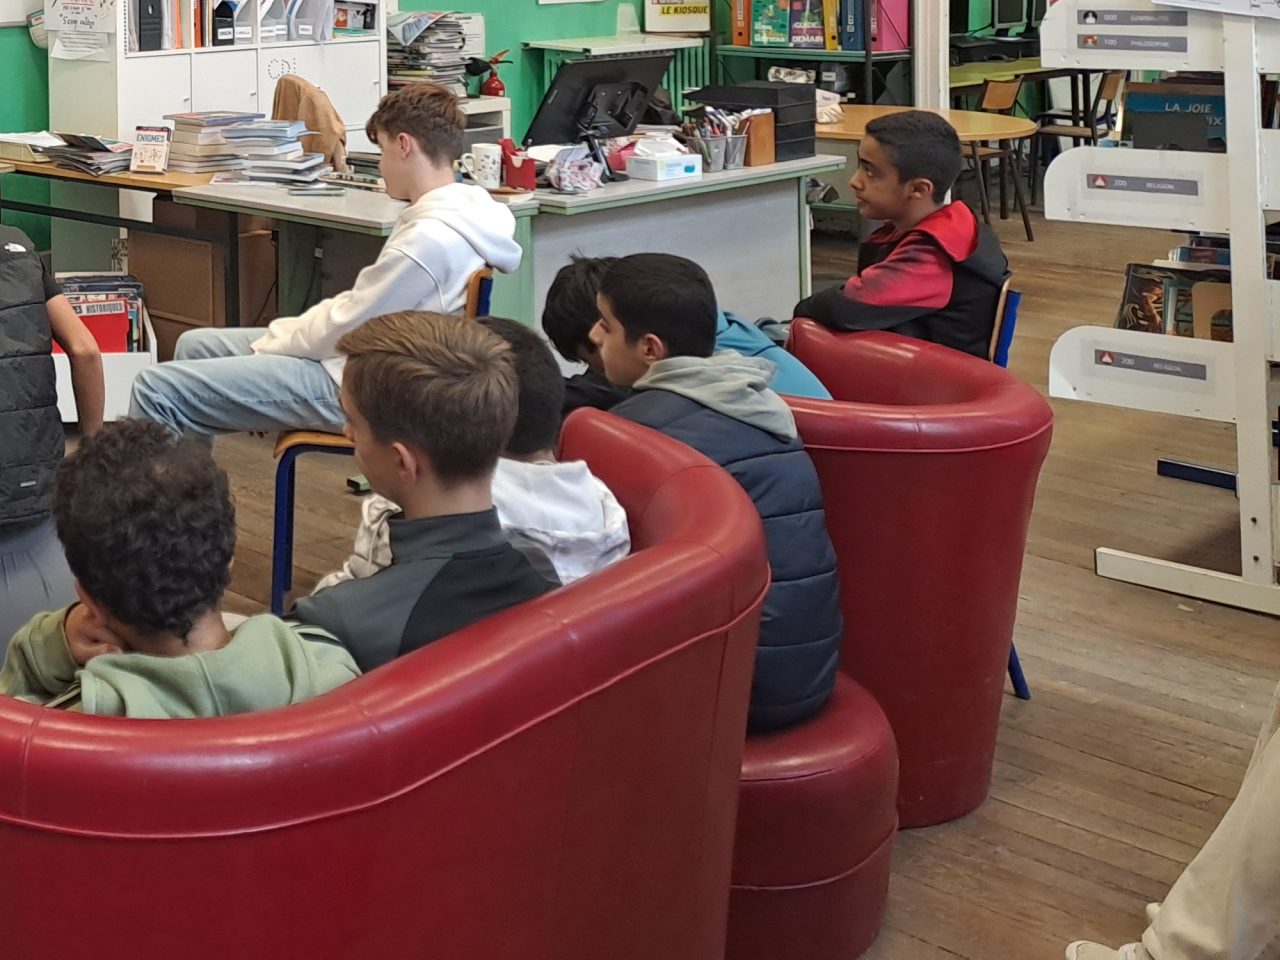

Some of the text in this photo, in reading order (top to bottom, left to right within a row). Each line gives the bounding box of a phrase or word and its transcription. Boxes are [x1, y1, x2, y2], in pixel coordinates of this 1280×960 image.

[661, 5, 709, 15] LE KIOSQUE
[1165, 102, 1213, 114] LA JOIE
[136, 133, 165, 143] ENIGMES
[86, 302, 123, 314] HISTORIQUES
